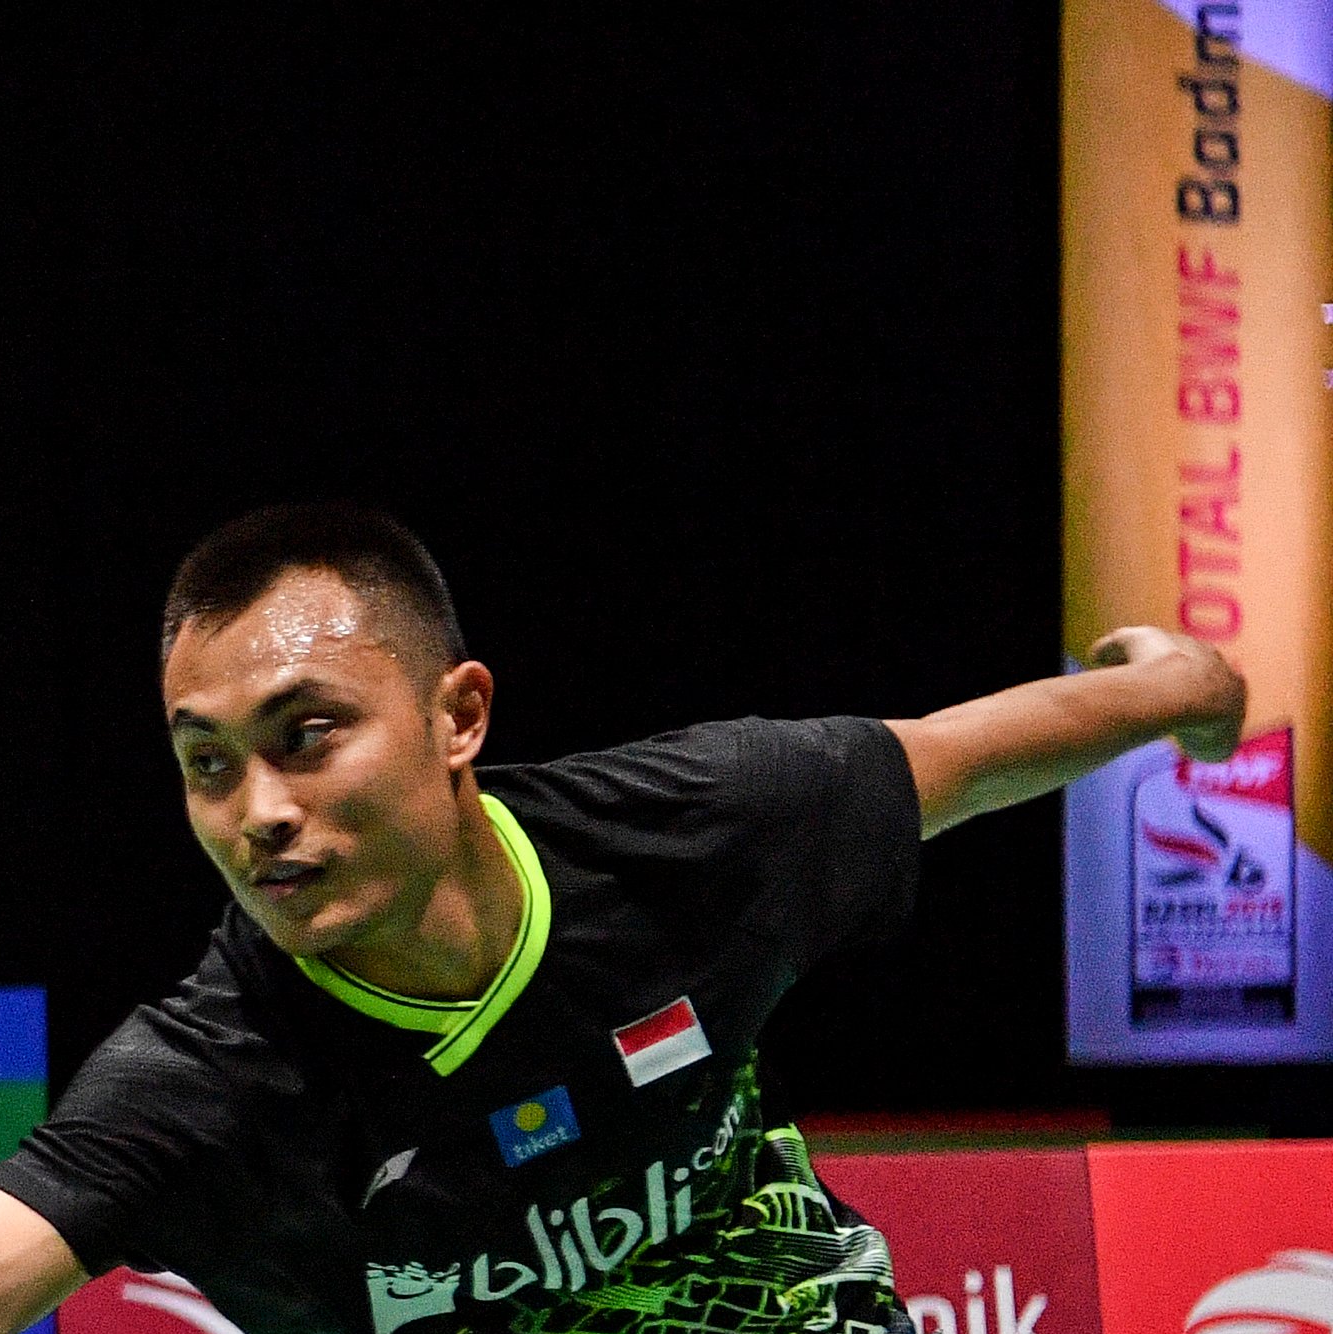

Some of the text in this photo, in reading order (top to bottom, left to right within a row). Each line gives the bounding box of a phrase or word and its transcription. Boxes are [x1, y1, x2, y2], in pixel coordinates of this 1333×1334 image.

[1176, 4, 1244, 643] OTAL BWF Badm
